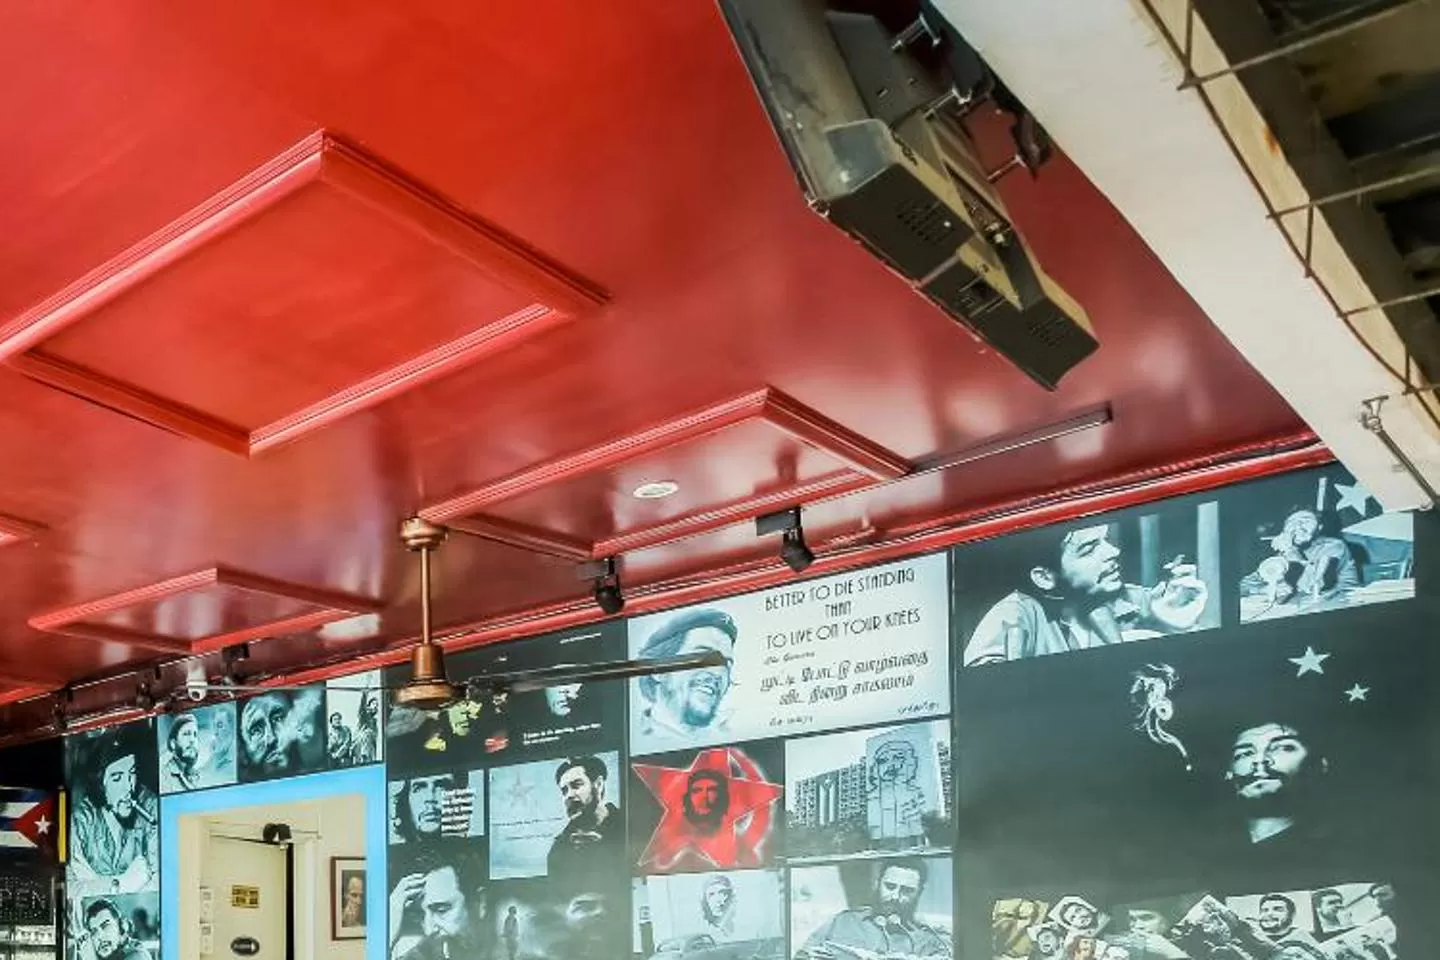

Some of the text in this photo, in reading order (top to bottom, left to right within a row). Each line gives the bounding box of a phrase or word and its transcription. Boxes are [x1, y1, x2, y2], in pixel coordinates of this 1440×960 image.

[765, 568, 915, 611] BETTER TO DIE STANDING
[825, 601, 852, 618] THAN
[767, 608, 921, 650] TO LIVE ON YOUR KNEES
